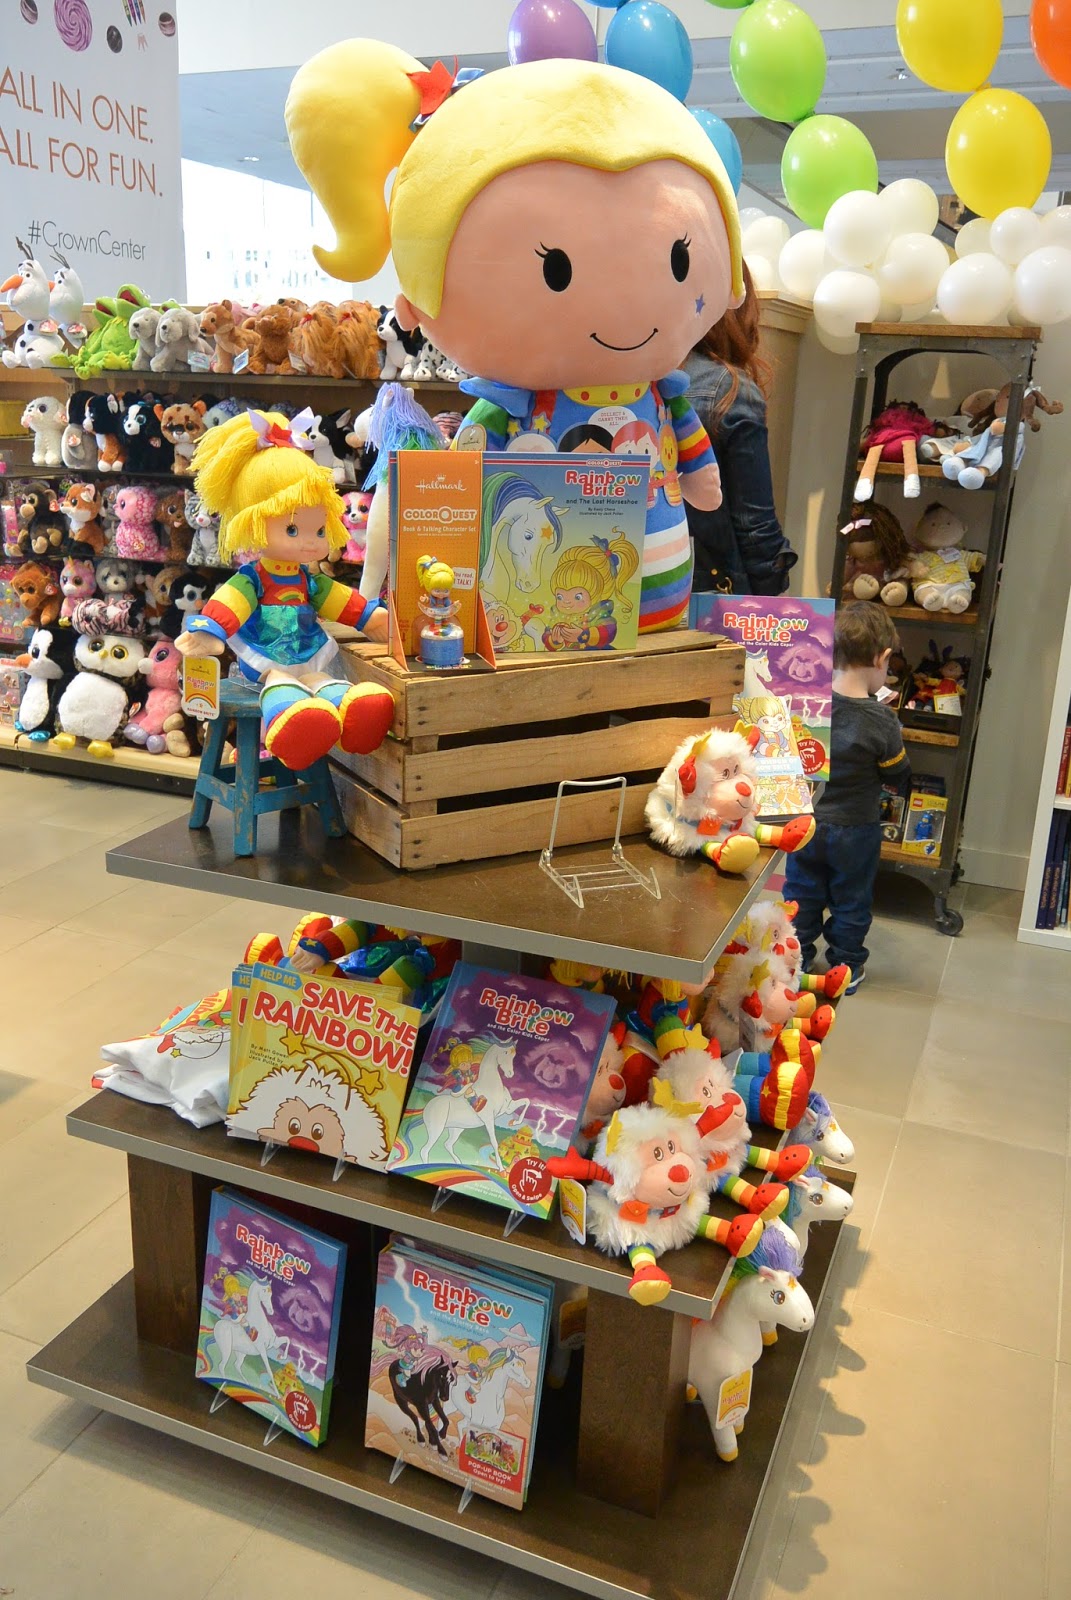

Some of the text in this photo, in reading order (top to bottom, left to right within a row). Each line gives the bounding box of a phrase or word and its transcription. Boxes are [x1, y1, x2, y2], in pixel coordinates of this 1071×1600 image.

[0, 66, 154, 144] ALL IN ONE.
[48, 136, 101, 183] FOR
[109, 152, 163, 197] FUN.
[28, 219, 146, 261] #CrownCenter
[415, 478, 467, 495] Hallmark
[565, 470, 642, 486] Rainbow
[582, 483, 626, 497] Brite
[403, 506, 477, 524] COLORQUEST
[422, 526, 442, 534] Talking
[457, 578, 472, 586] TALK!
[723, 612, 809, 631] Rainbow
[742, 627, 791, 642] Brite
[187, 675, 215, 687] Rainbow
[261, 968, 297, 987] HELP ME
[301, 981, 418, 1047] SAVE THE
[479, 987, 575, 1027] Rainbow
[495, 1007, 550, 1035] Brite
[253, 991, 414, 1075] RAINBOW!
[506, 1027, 521, 1035] Color
[521, 1030, 533, 1038] Kids
[534, 1034, 550, 1042] Caper
[249, 1049, 276, 1061] Illustrated
[526, 1159, 547, 1171] Try it!
[511, 1184, 523, 1200] Open
[526, 1193, 543, 1201] Swipe
[236, 1223, 311, 1275] Rainbow
[251, 1246, 294, 1280] Brite
[413, 1269, 513, 1319] Rainbow
[433, 1293, 490, 1327] Brite
[293, 1392, 303, 1400] Try
[468, 1460, 492, 1474] POP-UP
[492, 1469, 512, 1481] BOOK
[472, 1468, 488, 1478] Open
[495, 1477, 506, 1485] try!
